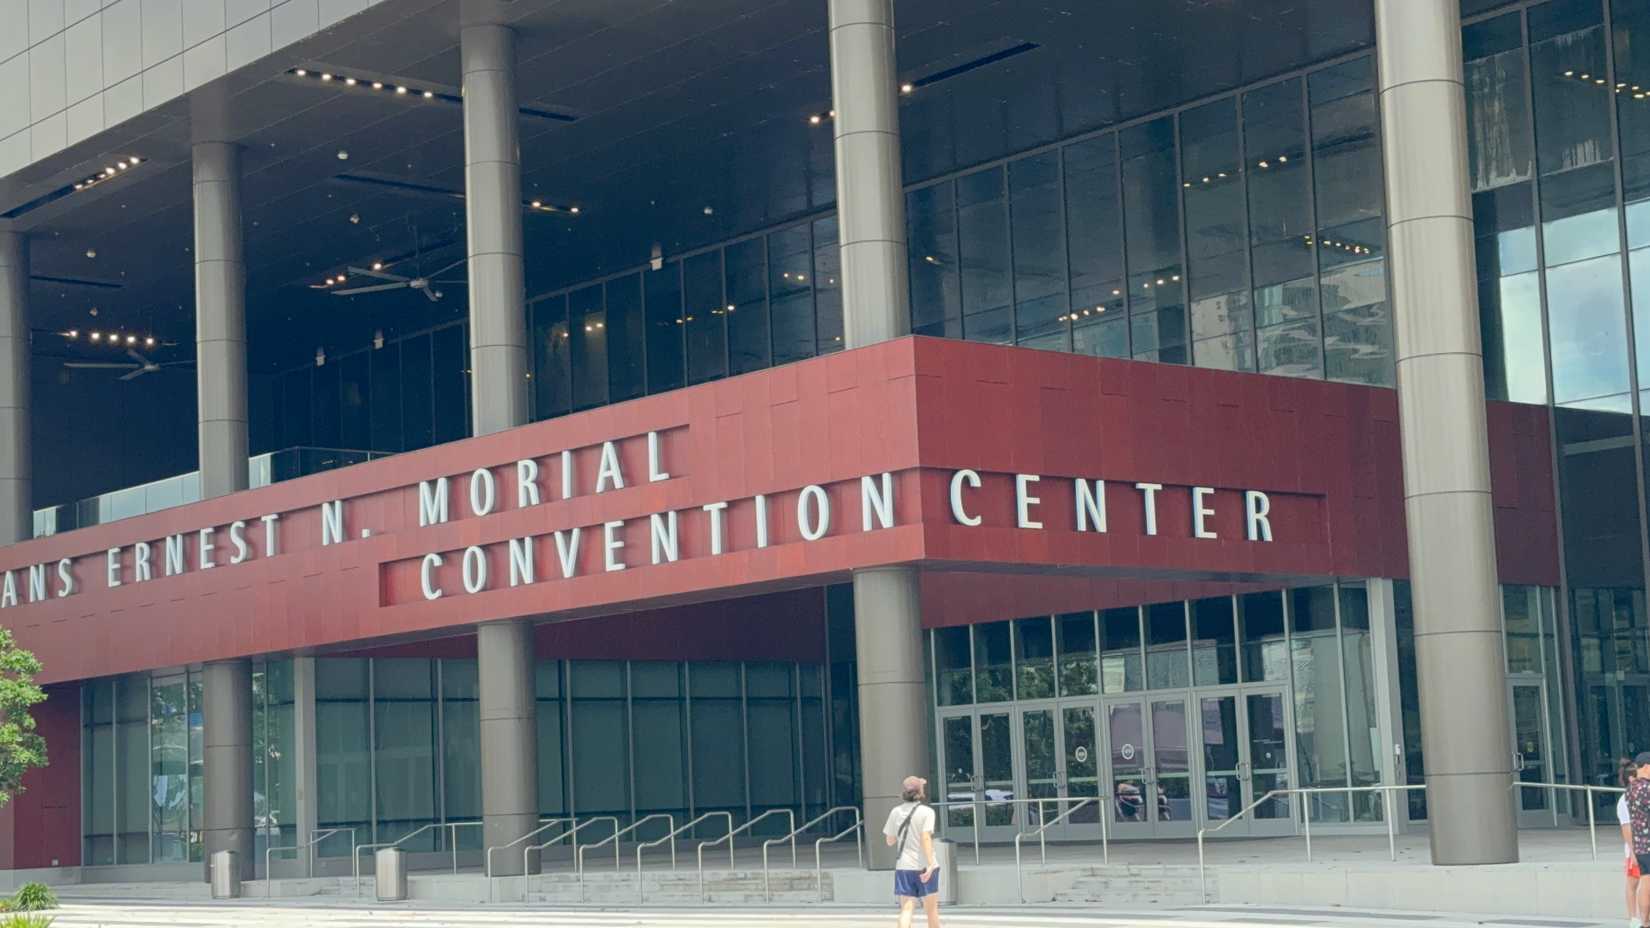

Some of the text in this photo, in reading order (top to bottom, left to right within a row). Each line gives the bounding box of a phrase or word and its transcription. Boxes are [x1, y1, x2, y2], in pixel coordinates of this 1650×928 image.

[1, 431, 670, 608] ANS ERNEST N. MORIAL
[420, 469, 1273, 600] CONVENTION CENTER
